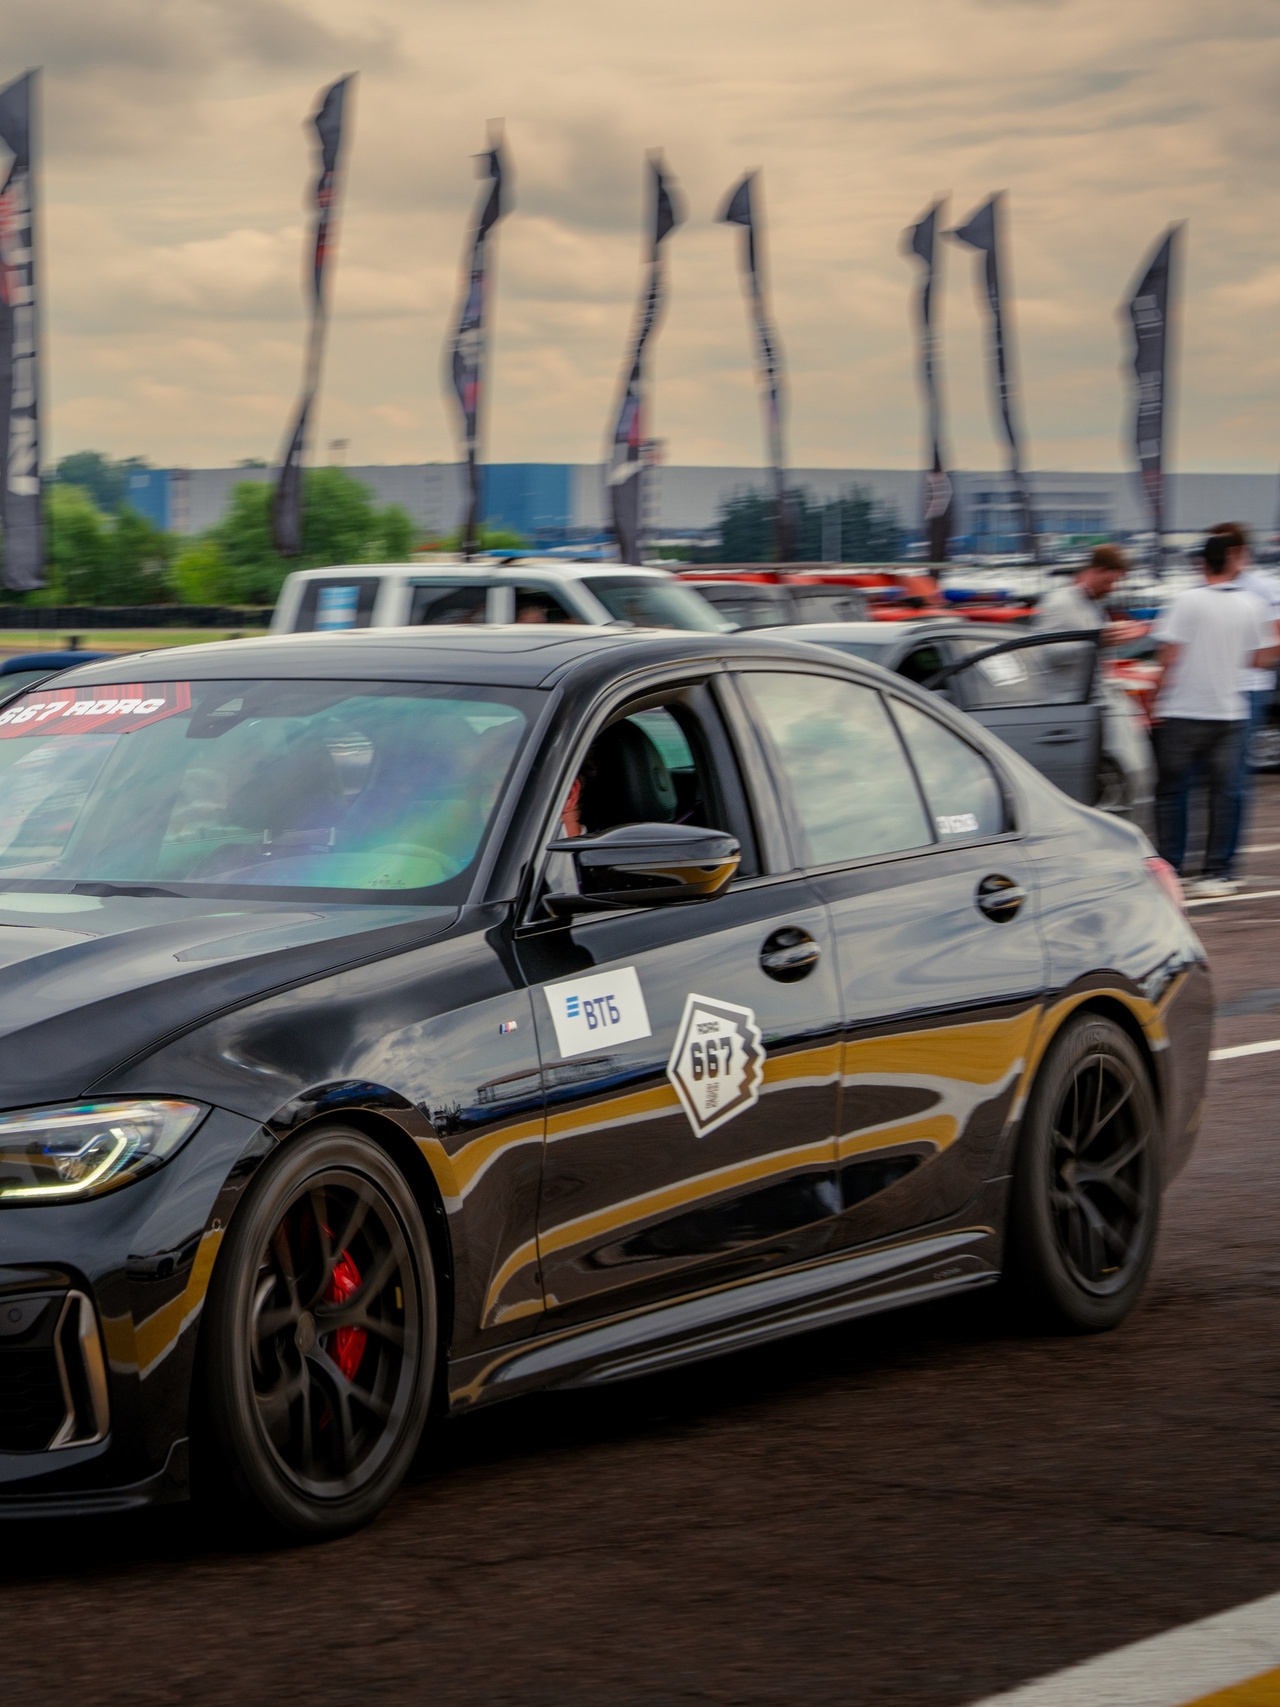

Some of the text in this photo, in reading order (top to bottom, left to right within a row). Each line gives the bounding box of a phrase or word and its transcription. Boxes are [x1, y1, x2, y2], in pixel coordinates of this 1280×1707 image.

[61, 698, 166, 717] RDRC
[582, 994, 621, 1030] ВТБ
[691, 1036, 733, 1081] 667
